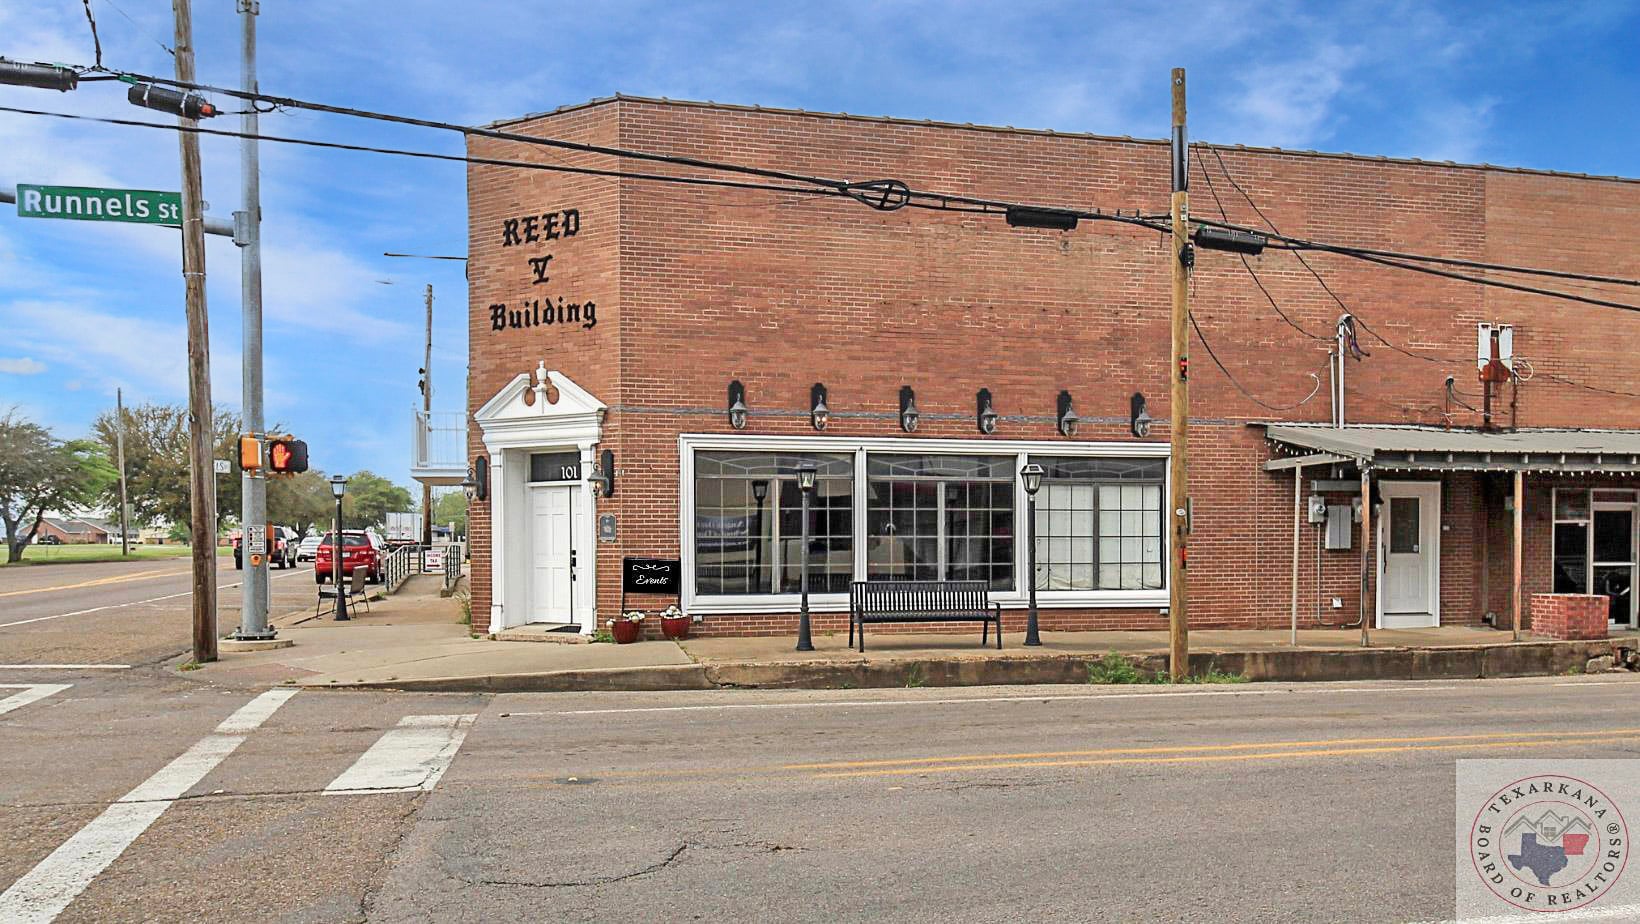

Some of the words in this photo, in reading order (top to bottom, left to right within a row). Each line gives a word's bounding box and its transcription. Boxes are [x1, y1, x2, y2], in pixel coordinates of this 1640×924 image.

[24, 189, 150, 218] Runnels
[158, 202, 179, 220] St
[502, 208, 580, 248] REED
[528, 254, 554, 285] V
[489, 296, 598, 332] Building
[561, 465, 578, 479] 101
[635, 574, 669, 585] Events
